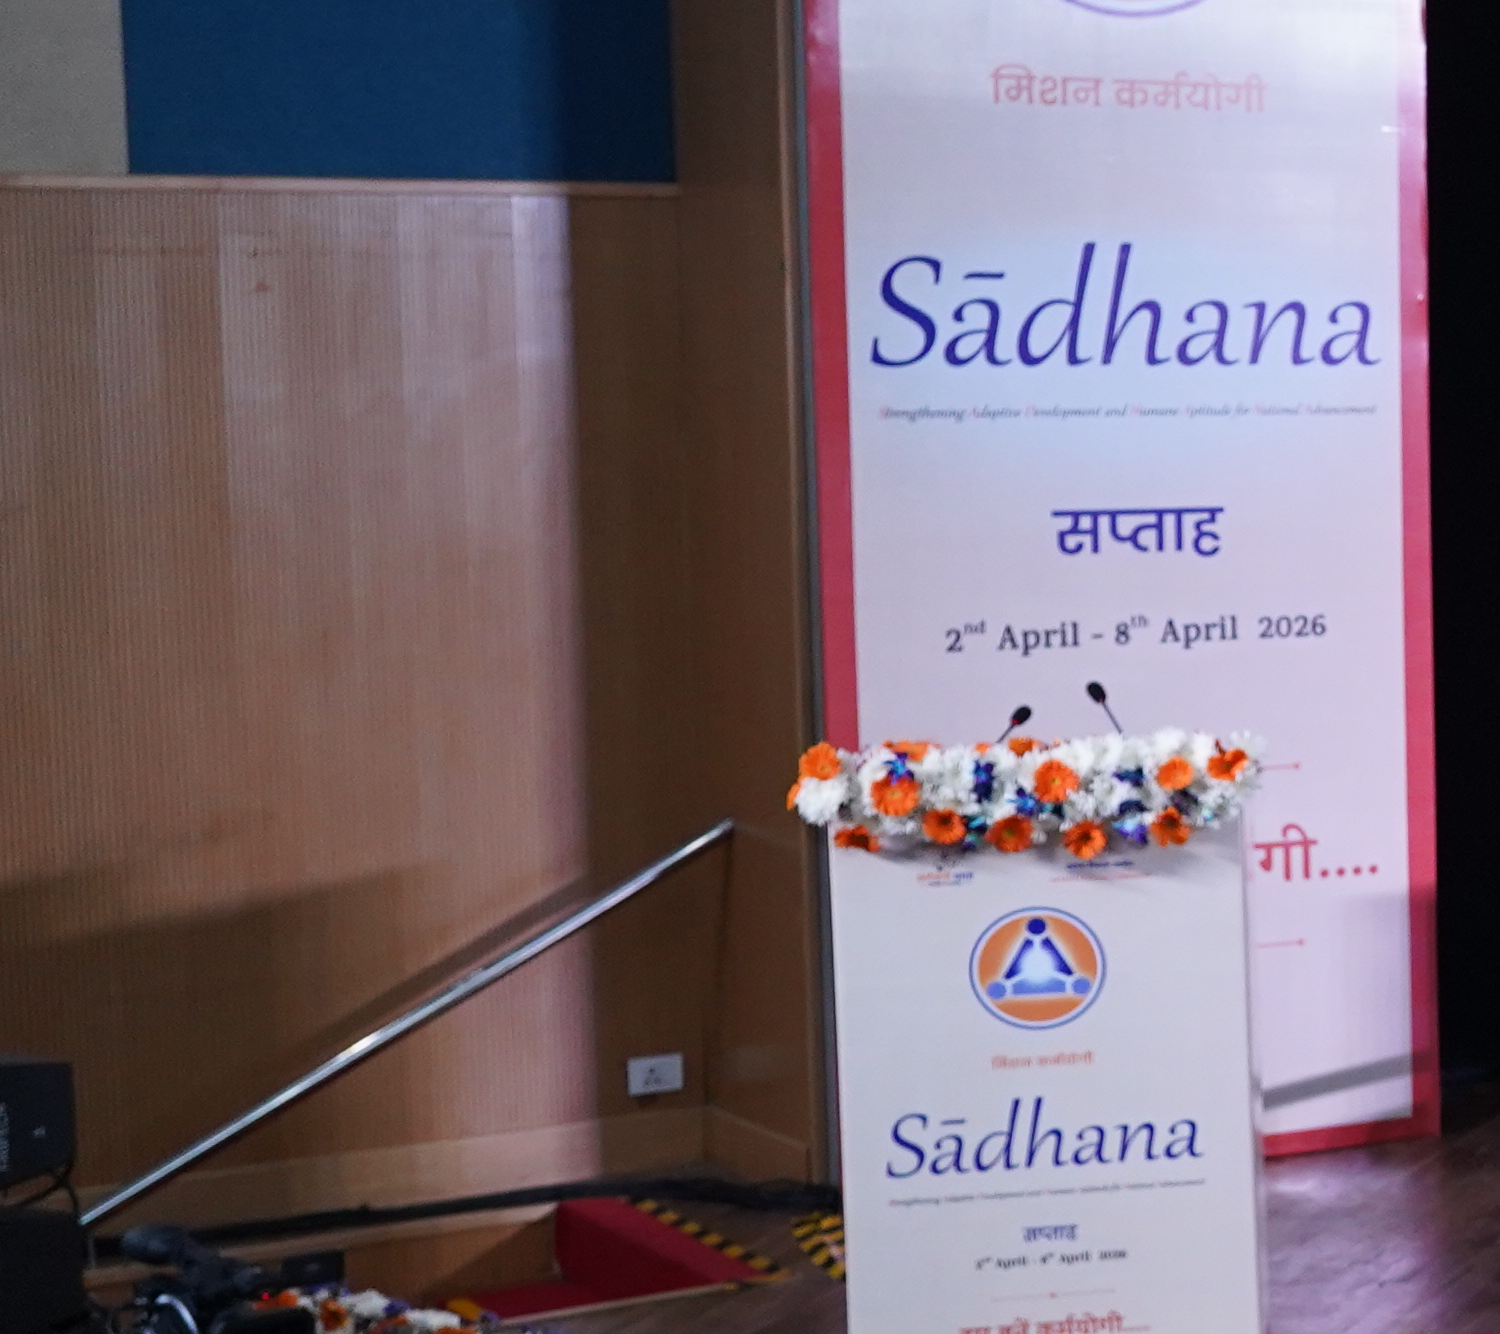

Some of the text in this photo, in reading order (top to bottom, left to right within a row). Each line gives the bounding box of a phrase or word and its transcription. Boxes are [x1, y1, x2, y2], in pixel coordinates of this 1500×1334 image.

[989, 63, 1267, 115] मिशन कर्मयोगी
[870, 241, 1383, 370] Sādhana
[1051, 503, 1226, 557] सप्ताह
[997, 619, 1082, 656] April
[1160, 614, 1240, 651] April
[1257, 614, 1328, 640] 2026
[885, 1095, 1204, 1179] Sādhana
